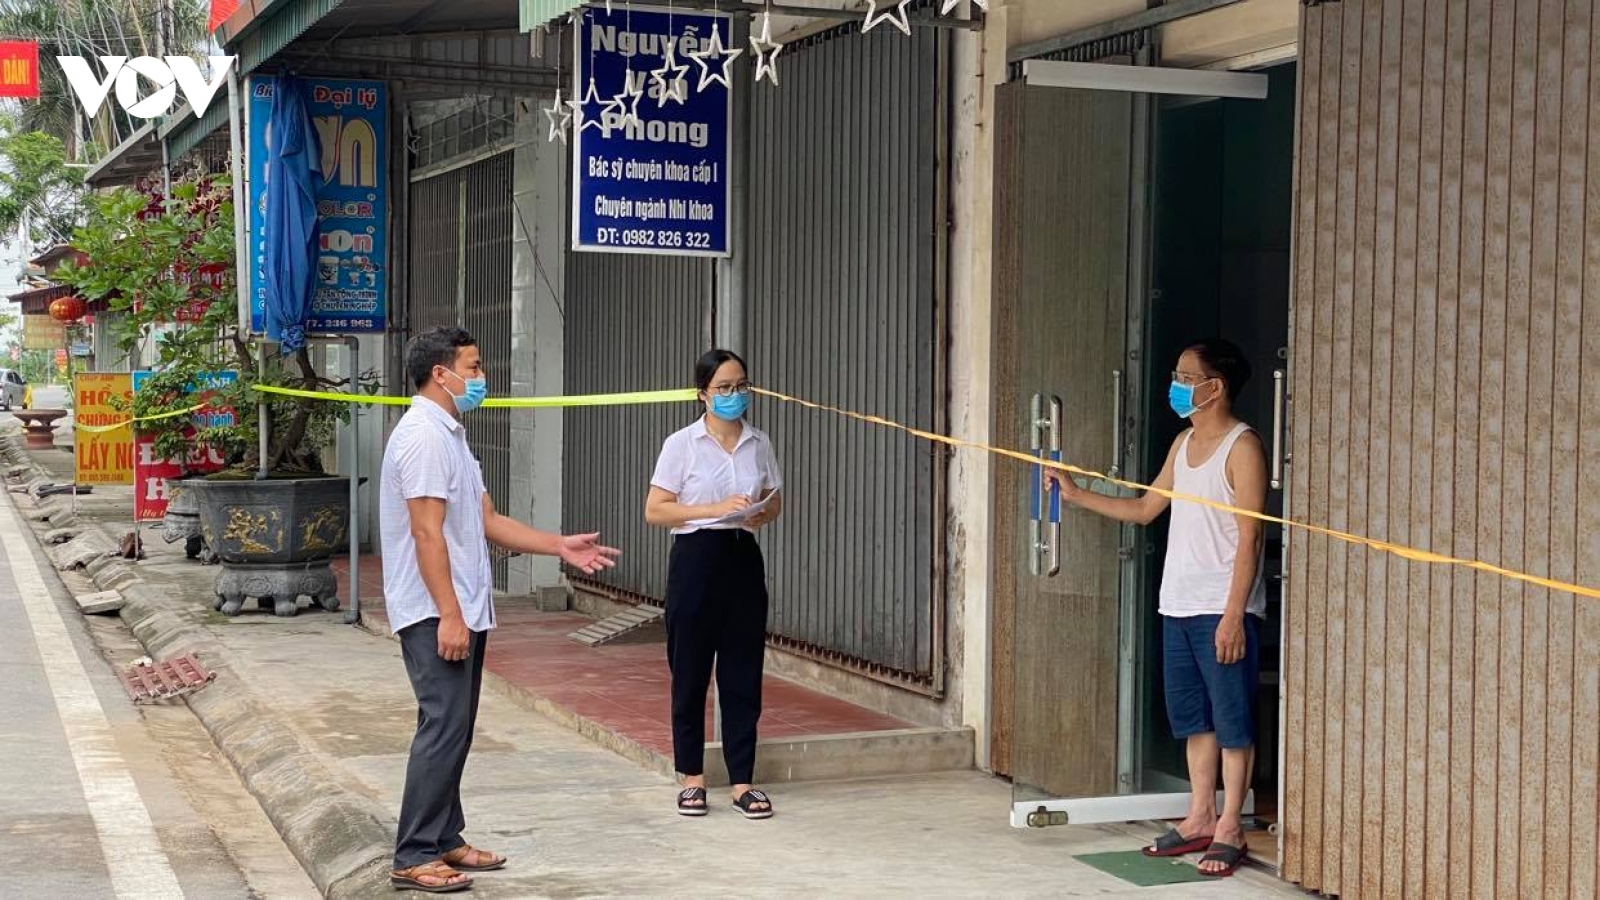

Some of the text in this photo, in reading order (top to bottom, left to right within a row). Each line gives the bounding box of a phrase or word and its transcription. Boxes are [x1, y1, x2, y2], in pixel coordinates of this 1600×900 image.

[592, 24, 719, 60] Nguyễn
[314, 85, 377, 110] Đại lý
[603, 112, 708, 148] Phong
[589, 155, 609, 178] Bác
[611, 157, 623, 181] sỹ
[625, 159, 662, 182] chuyên
[665, 160, 690, 181] khoa
[692, 159, 711, 185] cấp
[594, 194, 713, 221] Chuyên ngành Nhi khoa
[597, 227, 710, 248] ĐT: 0982 826 322
[79, 434, 109, 470] LẤY
